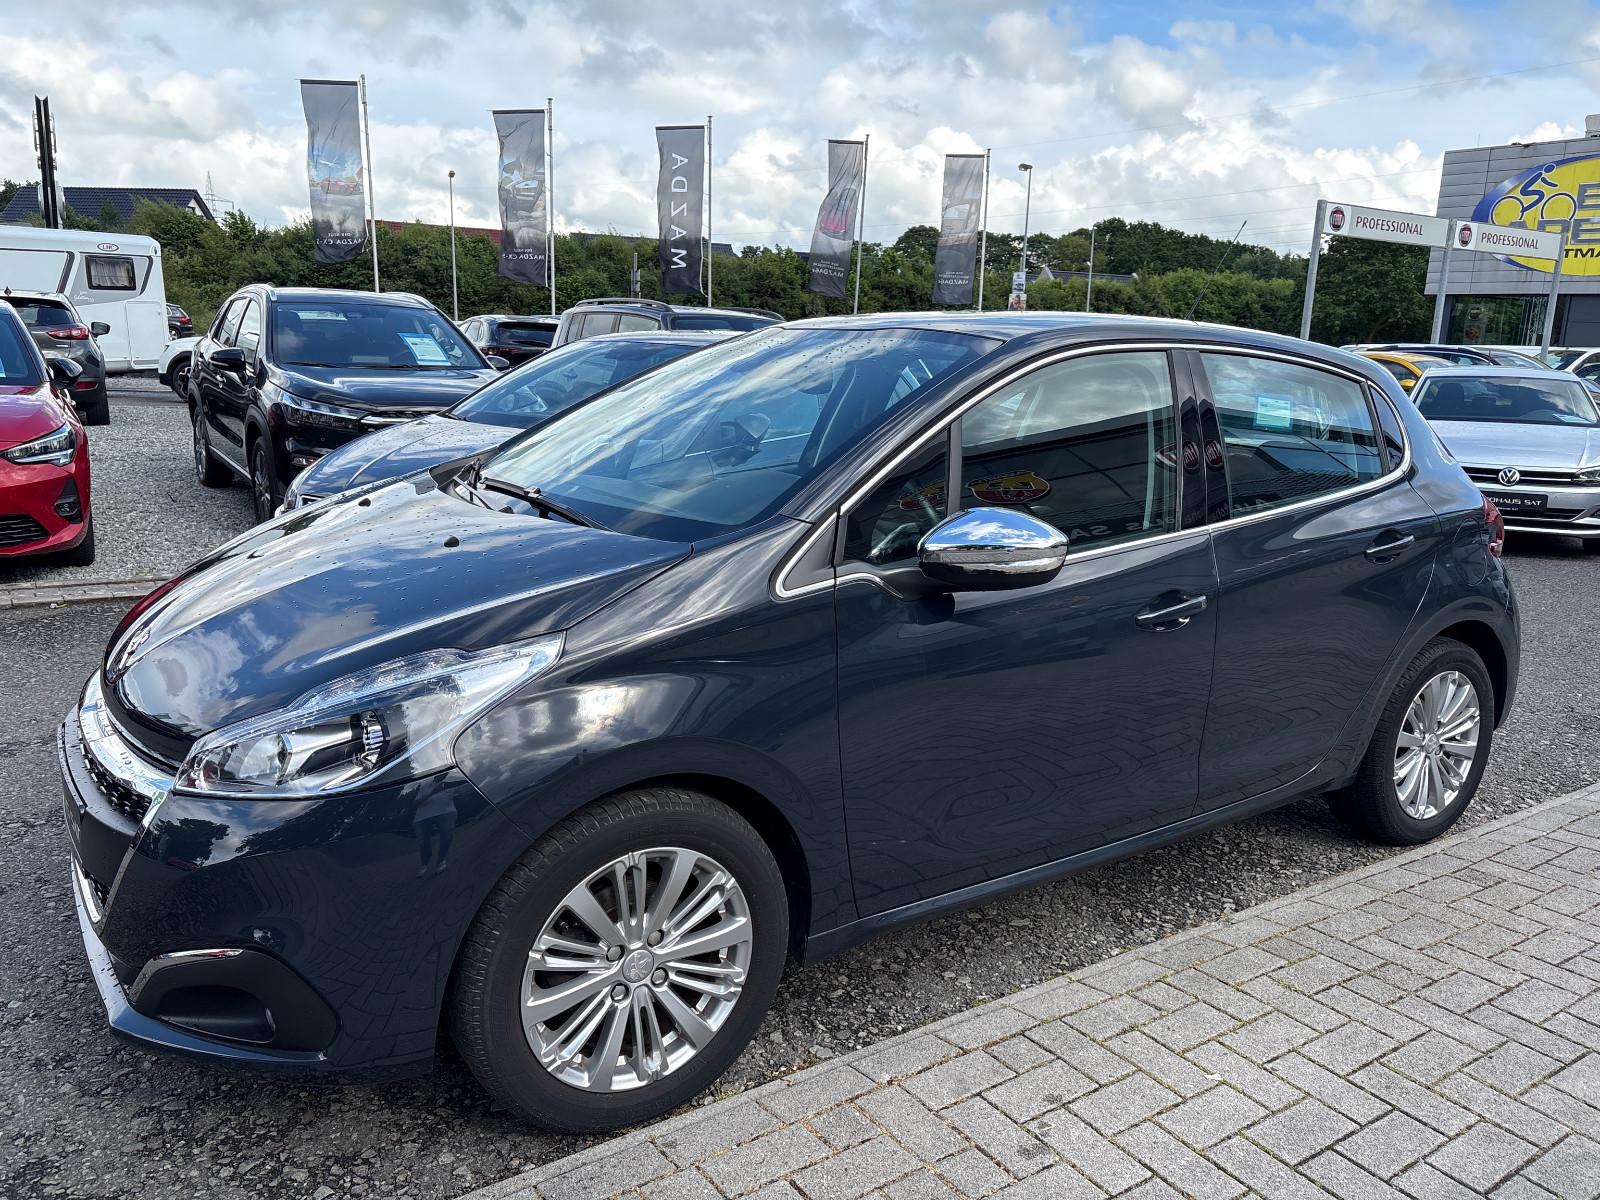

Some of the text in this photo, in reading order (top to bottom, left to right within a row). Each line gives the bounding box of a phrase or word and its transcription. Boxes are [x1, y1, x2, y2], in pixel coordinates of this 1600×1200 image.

[1355, 215, 1424, 236] PROFESSIONAL
[1480, 232, 1539, 250] PROFESSIONAL
[1488, 496, 1521, 505] OHAUS
